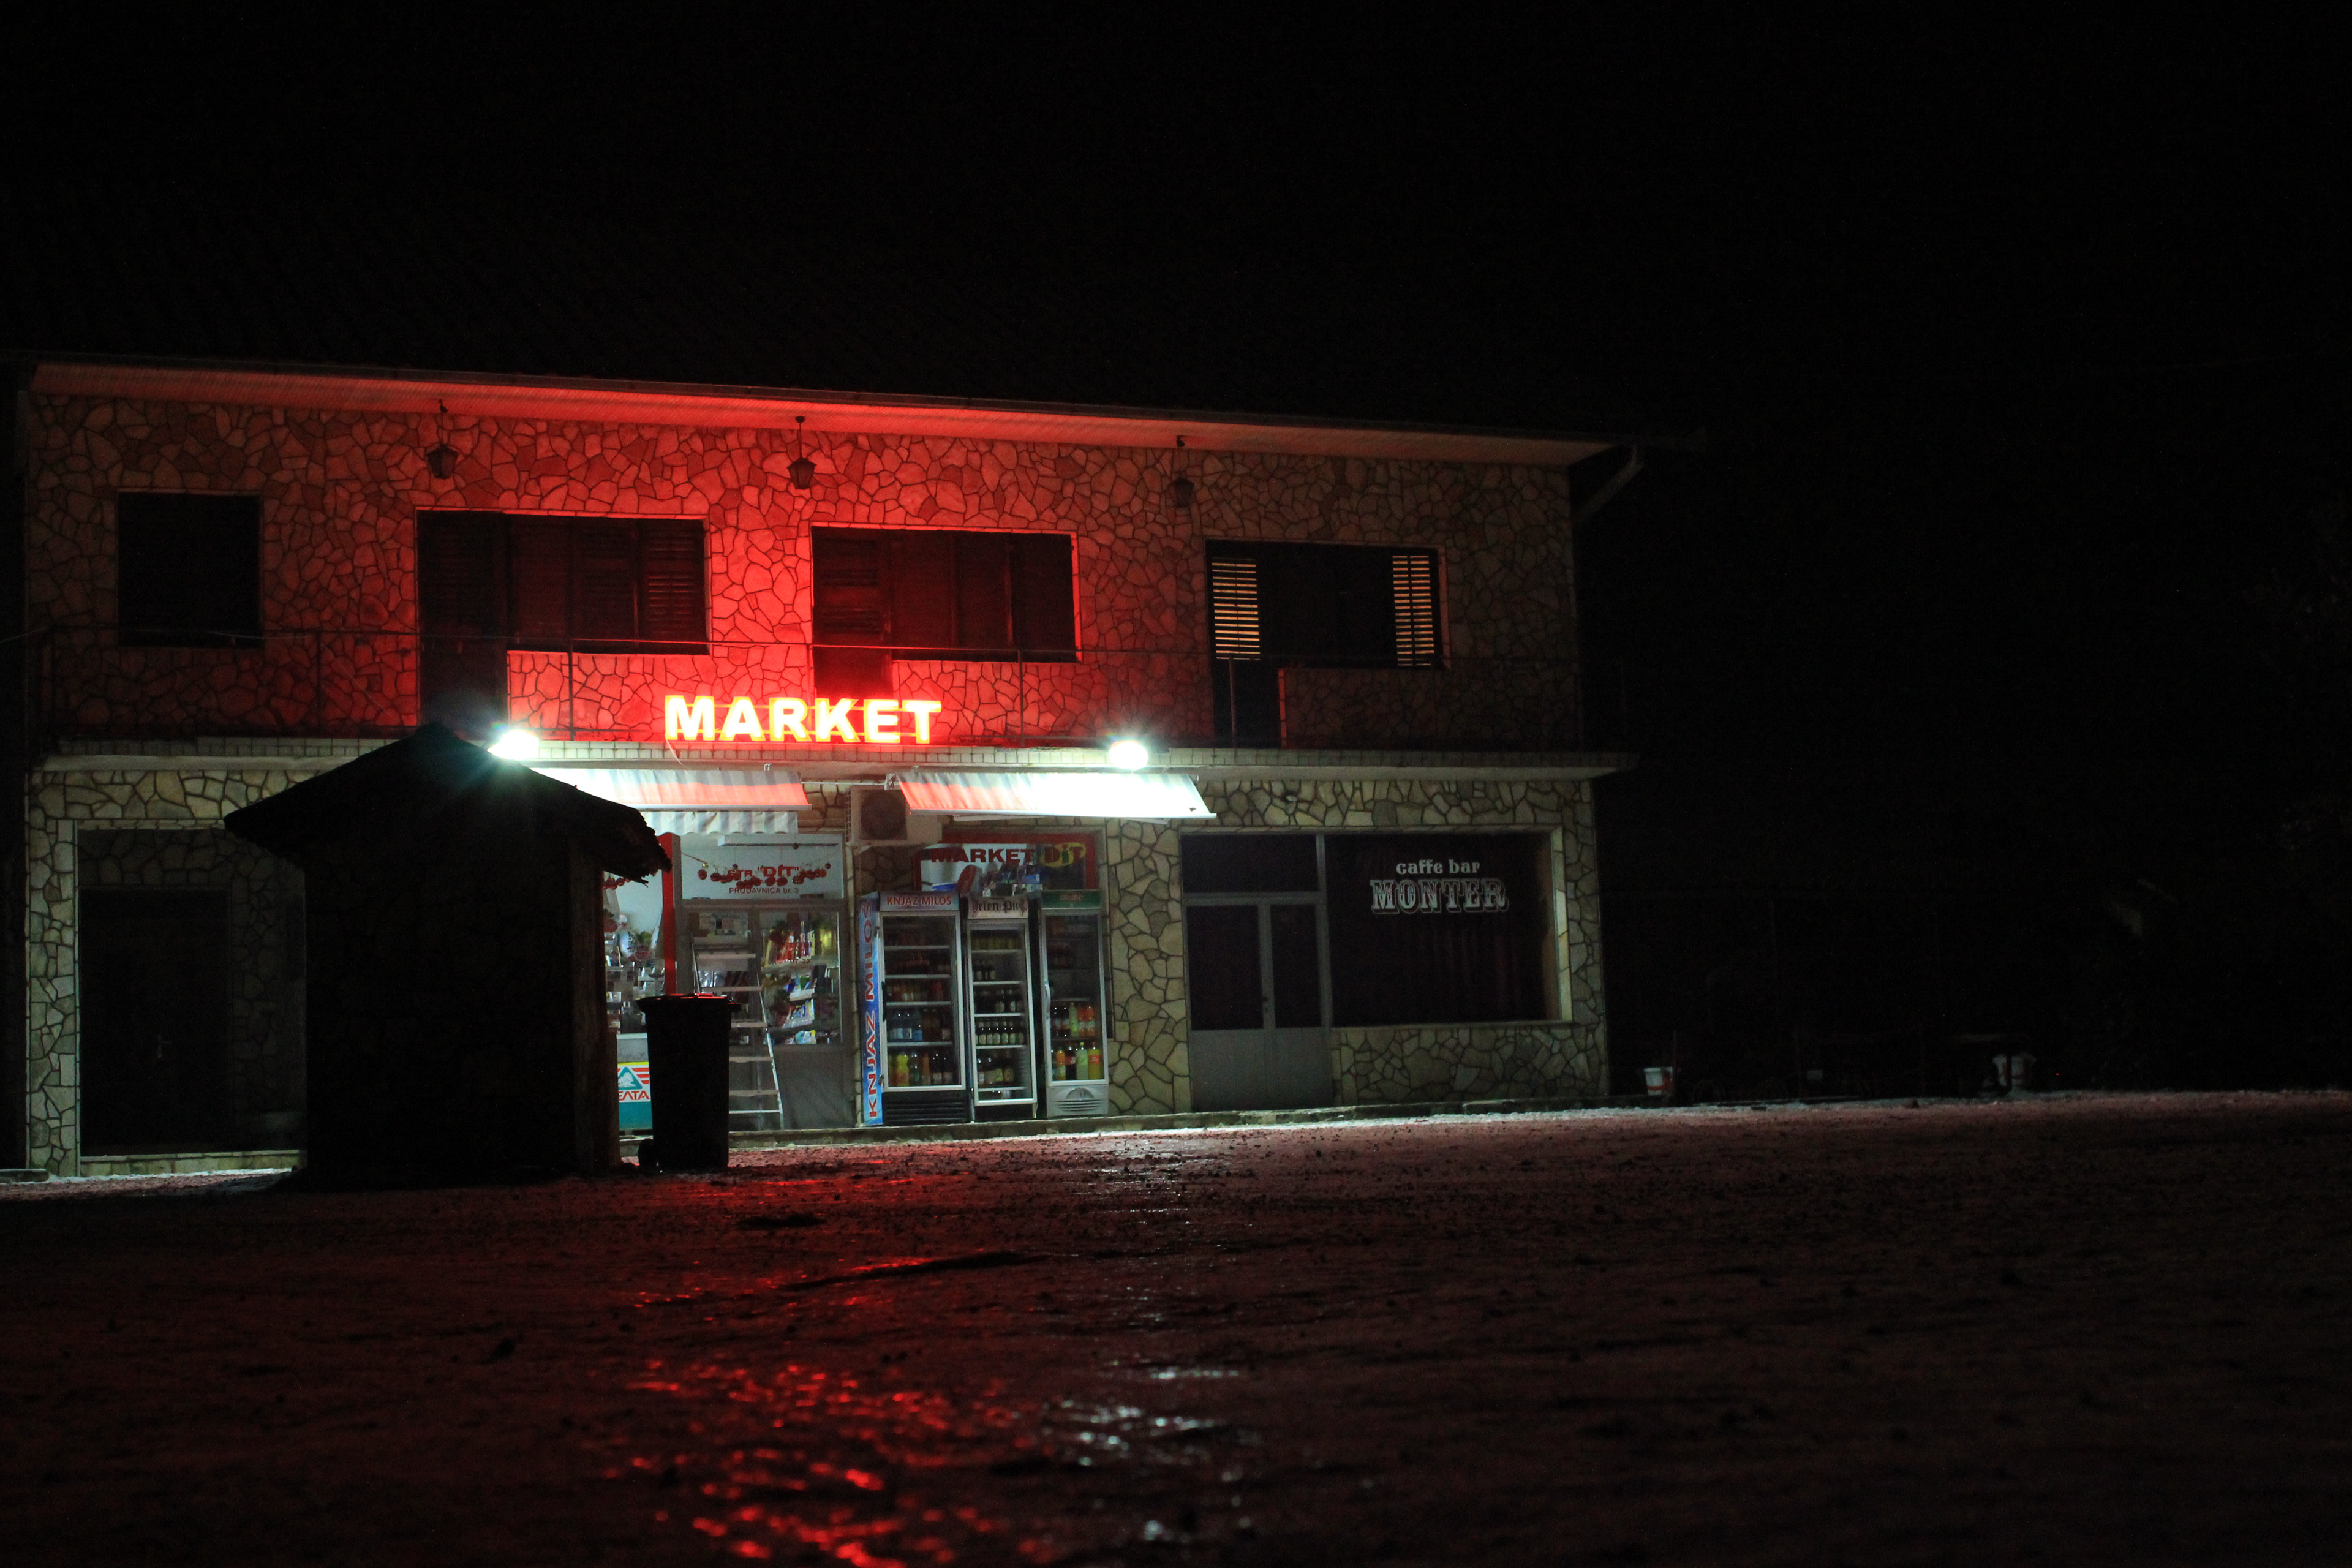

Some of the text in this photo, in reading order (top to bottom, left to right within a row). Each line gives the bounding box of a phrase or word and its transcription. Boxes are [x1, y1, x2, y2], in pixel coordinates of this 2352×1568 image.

[665, 695, 942, 744] MARKET
[931, 848, 1034, 863] MARKET
[1396, 859, 1480, 874] caffe bar
[887, 897, 919, 905] KNJAZ
[1370, 878, 1509, 914] MONTER
[865, 1011, 878, 1118] KNJAZ
